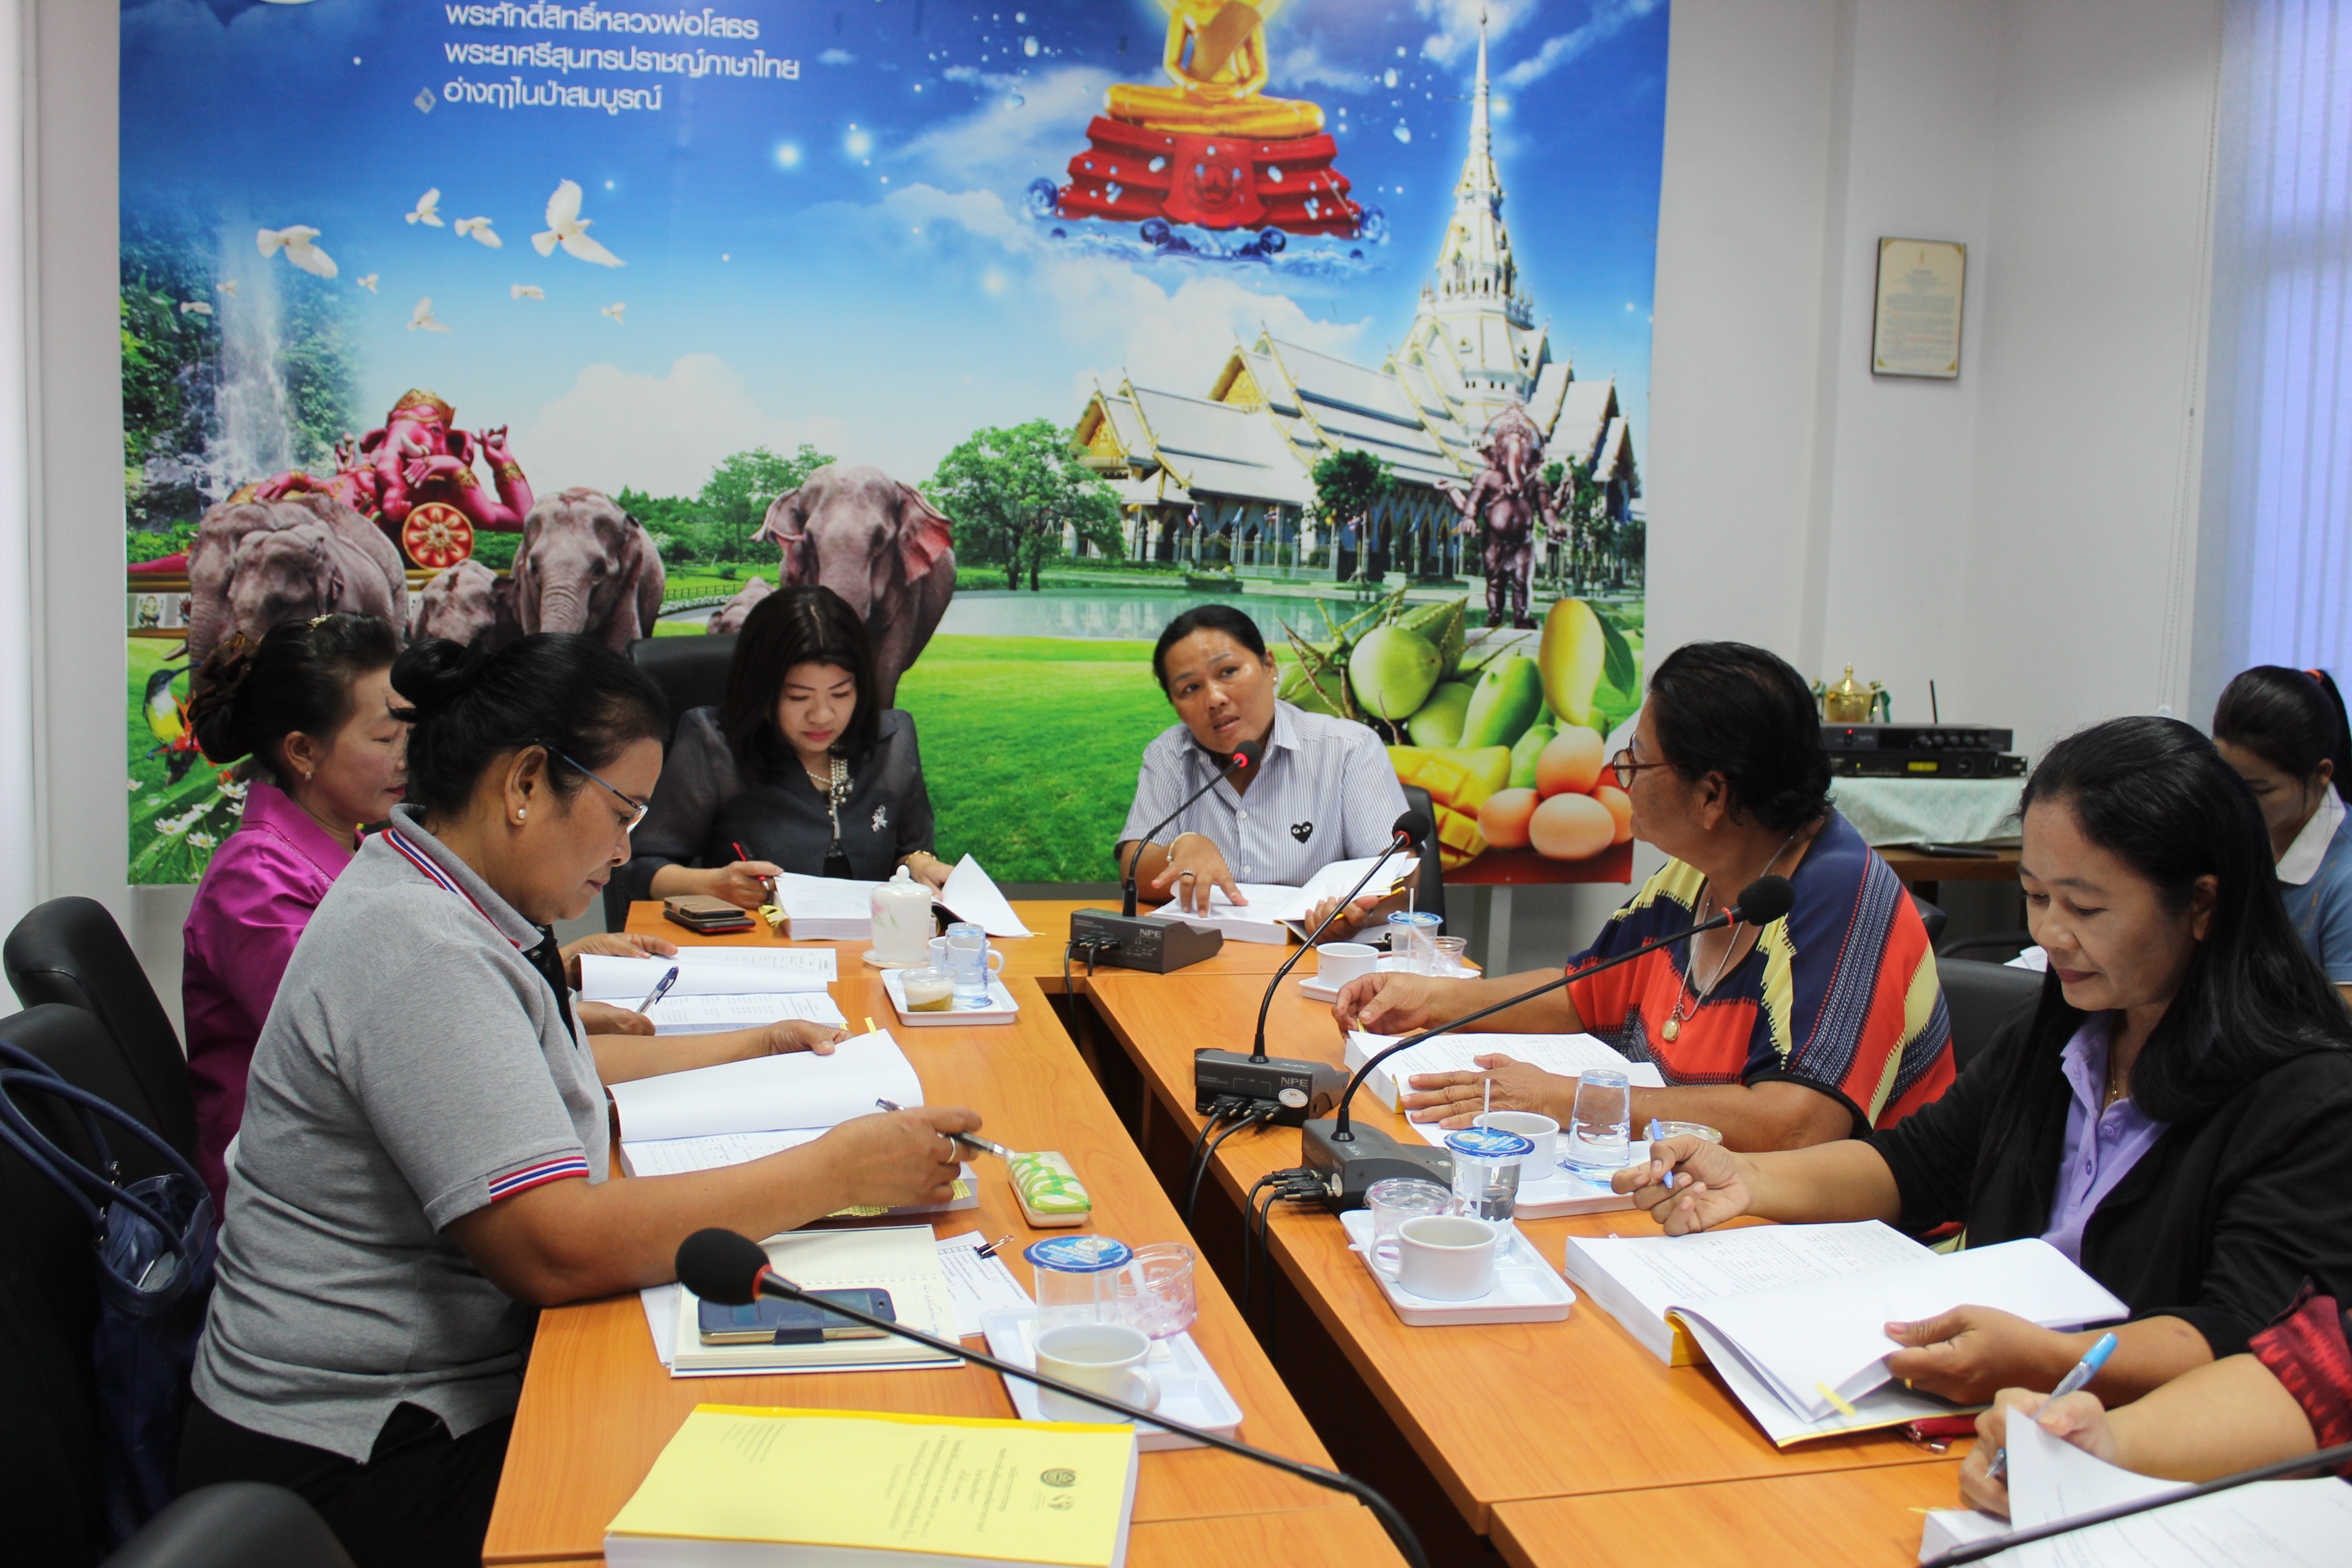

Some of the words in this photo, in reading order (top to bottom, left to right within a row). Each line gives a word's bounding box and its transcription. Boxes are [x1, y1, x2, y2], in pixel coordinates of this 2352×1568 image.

[445, 0, 760, 40] พระศักดิ์สิทธิ์หลวงพ่อโสธร
[444, 41, 800, 80] พระยาศรีสุนทรปราชญ์ภาษาไทย
[1139, 928, 1162, 938] NPE
[1281, 1077, 1308, 1087] NPE
